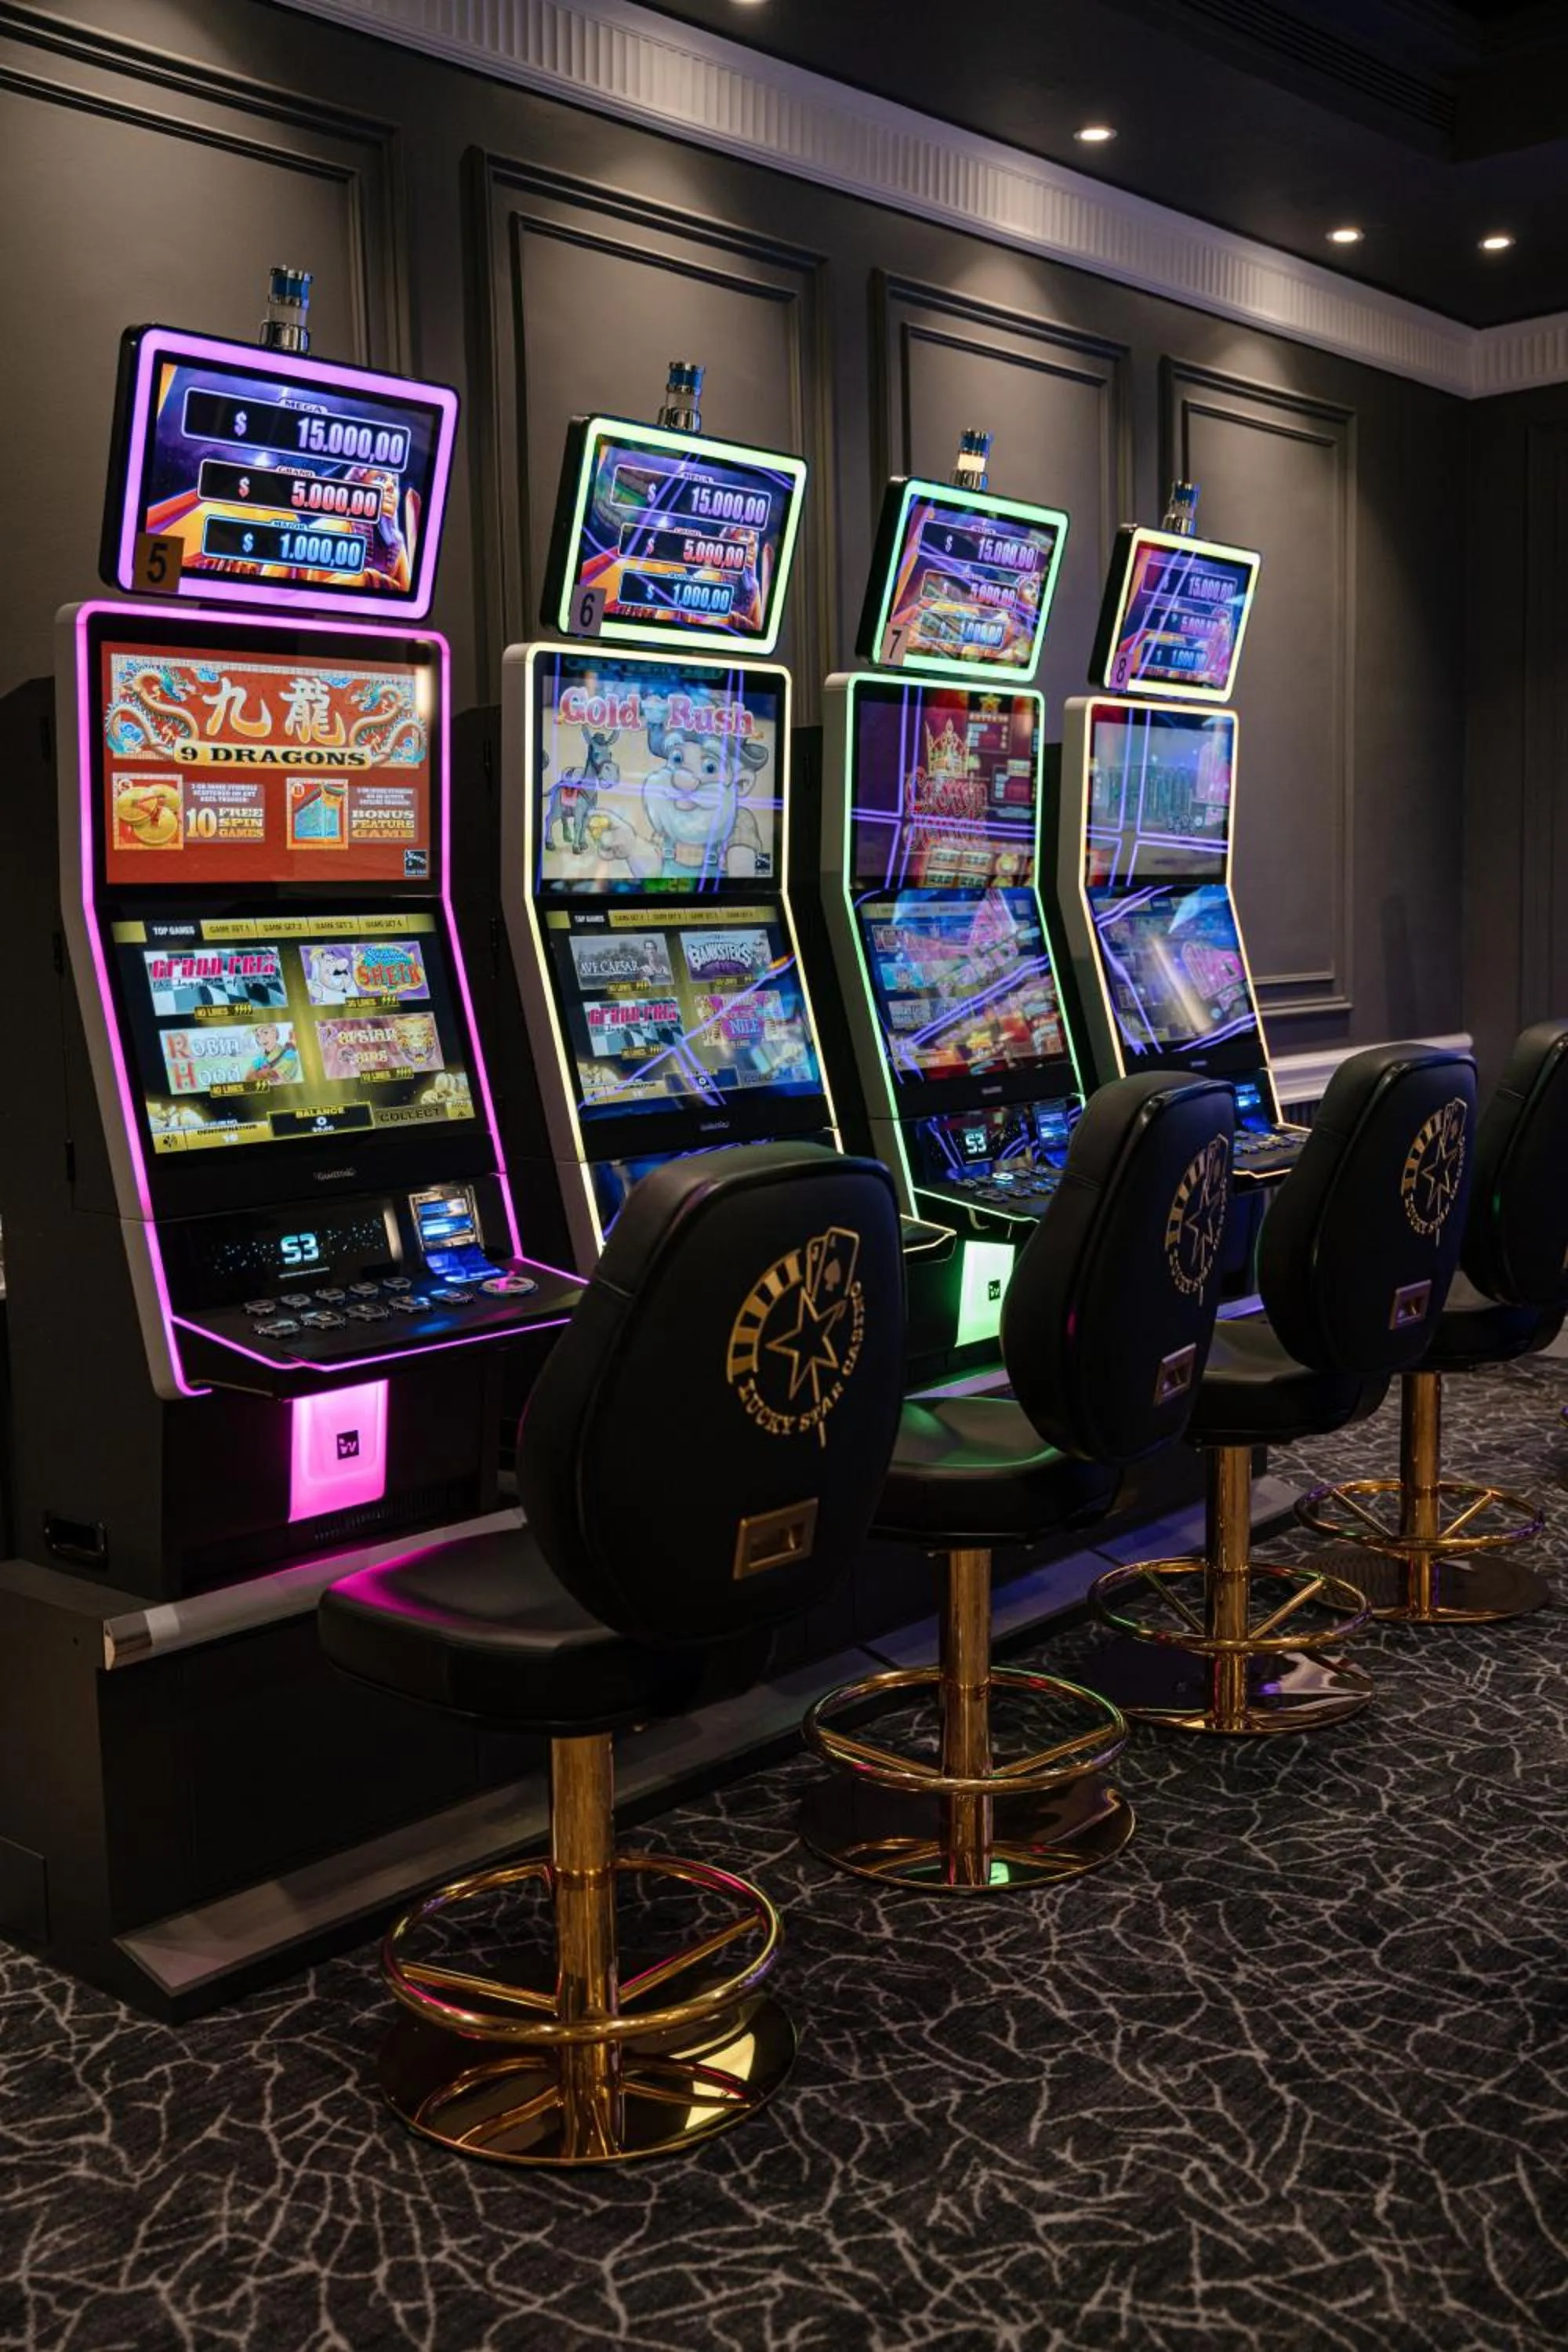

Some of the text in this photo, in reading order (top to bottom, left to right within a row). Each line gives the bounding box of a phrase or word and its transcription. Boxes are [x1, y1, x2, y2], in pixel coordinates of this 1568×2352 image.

[234, 412, 404, 464] $ 15.000,00
[238, 477, 377, 517] $ 5.000,00
[691, 487, 766, 524] 15.000,00
[147, 543, 168, 583] 5
[242, 533, 361, 568] $ 1.000,00
[684, 539, 744, 568] 5.000,00
[579, 593, 595, 627] 6
[673, 583, 728, 610] 1.000,00
[889, 630, 902, 659] 7
[1116, 658, 1127, 683] 8
[202, 677, 347, 746] 九龍
[560, 686, 754, 738] Gold Rush
[180, 747, 366, 767] 9 DRAGONS
[187, 808, 216, 837] 10
[220, 808, 263, 817] FREE
[220, 818, 263, 827] SPIN
[352, 810, 414, 819] BONUS
[152, 925, 195, 936] TOP GAMES
[356, 962, 422, 986] SHEIK
[167, 1032, 241, 1059] Robin
[174, 1061, 241, 1090] Hood
[296, 1107, 345, 1118] BALANCE
[380, 1108, 440, 1122] COLLECT
[280, 1232, 319, 1265] S3
[739, 1377, 796, 1435] LUCKY
